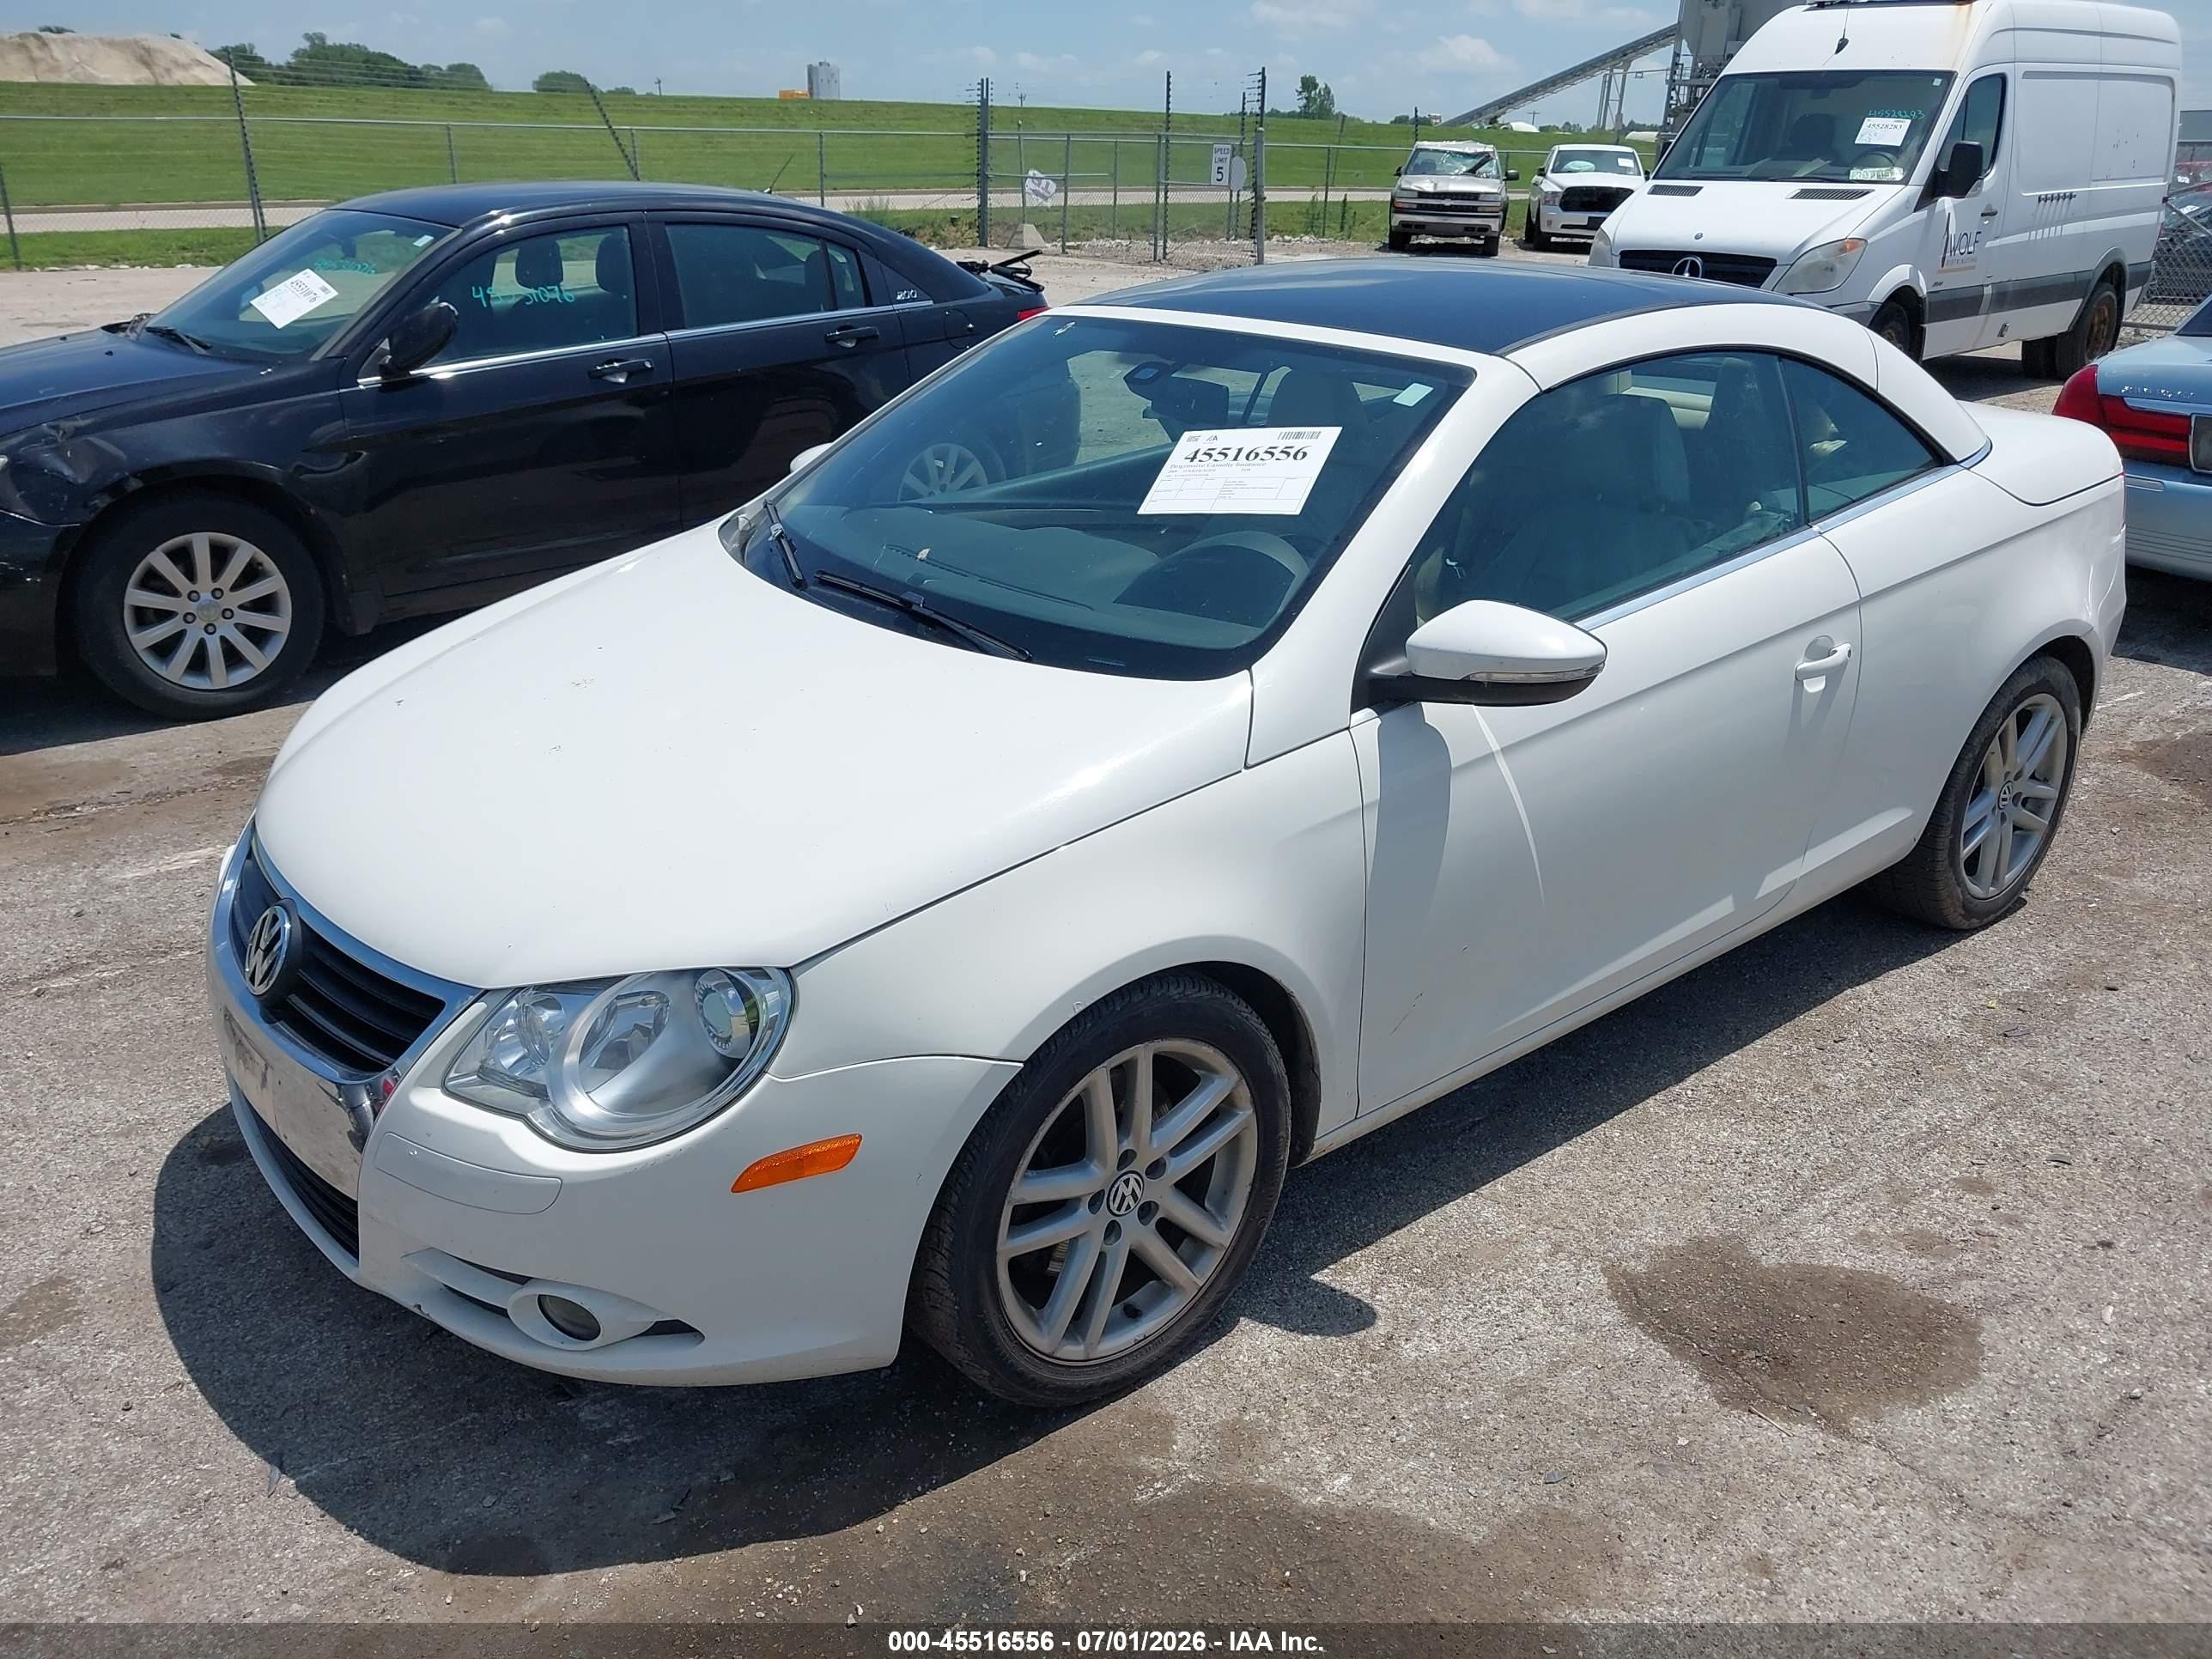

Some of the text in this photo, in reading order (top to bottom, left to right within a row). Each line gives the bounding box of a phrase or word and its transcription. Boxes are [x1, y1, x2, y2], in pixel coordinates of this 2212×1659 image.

[1216, 167, 1224, 182] 5
[1950, 230, 1982, 257] WOLF
[896, 289, 918, 301] 200
[1184, 445, 1312, 464] 45516556
